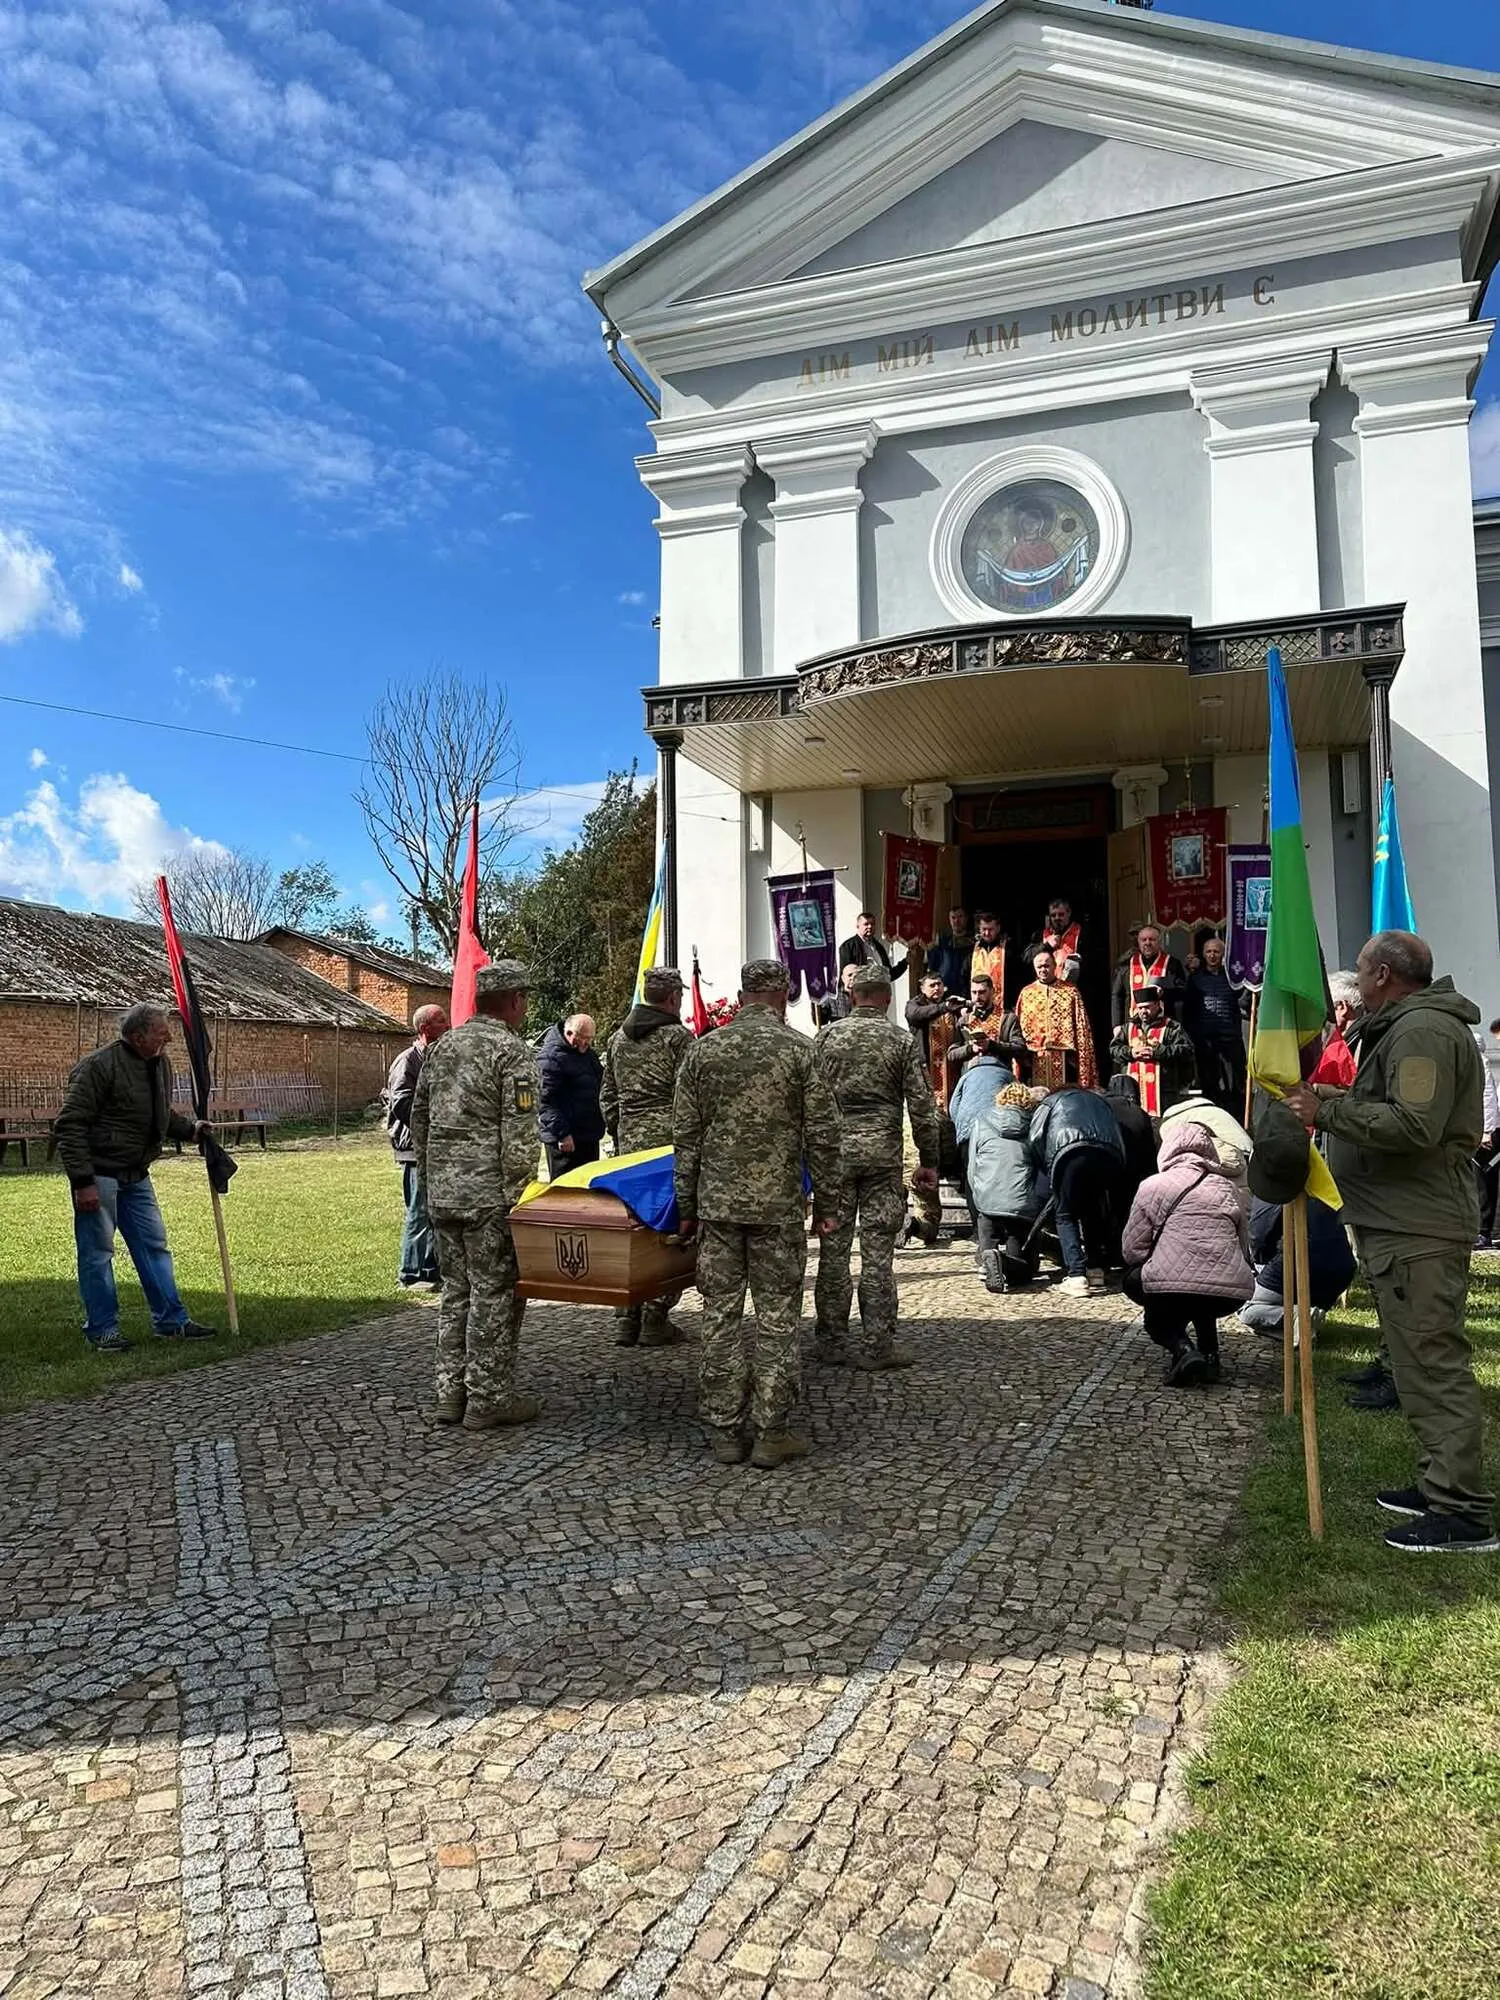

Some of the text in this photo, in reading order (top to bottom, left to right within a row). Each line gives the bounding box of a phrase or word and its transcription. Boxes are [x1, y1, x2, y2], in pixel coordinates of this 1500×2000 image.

[797, 274, 1275, 389] ДІМ МІЙ ДІМ МОЛИТВИ Є
